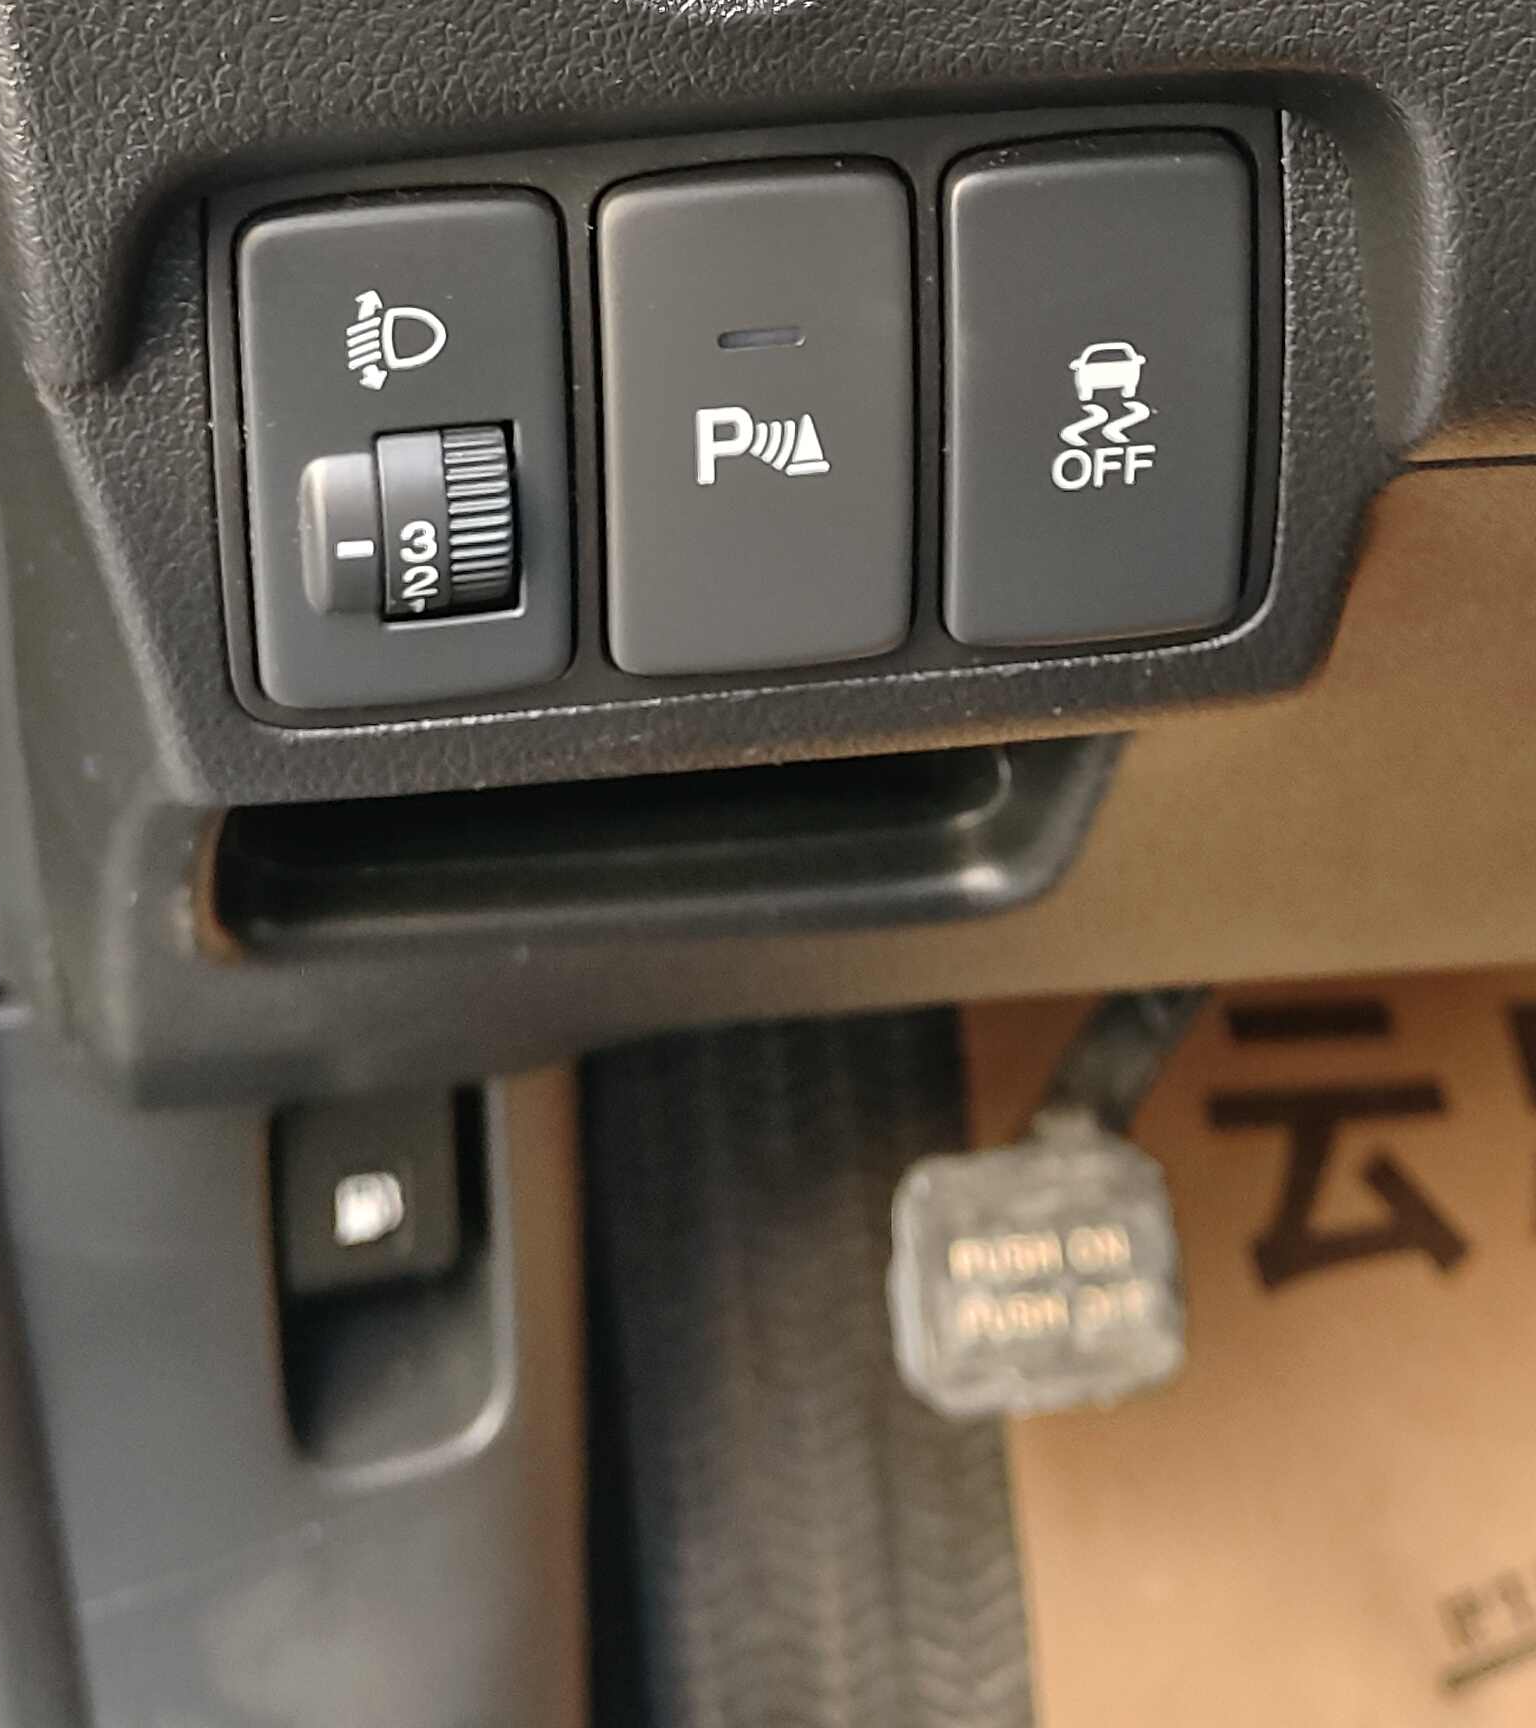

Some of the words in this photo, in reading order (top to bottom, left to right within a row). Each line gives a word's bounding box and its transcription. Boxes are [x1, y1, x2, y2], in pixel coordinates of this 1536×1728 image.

[1051, 444, 1157, 492] OFF
[399, 520, 438, 564] 3
[401, 565, 440, 600] 2
